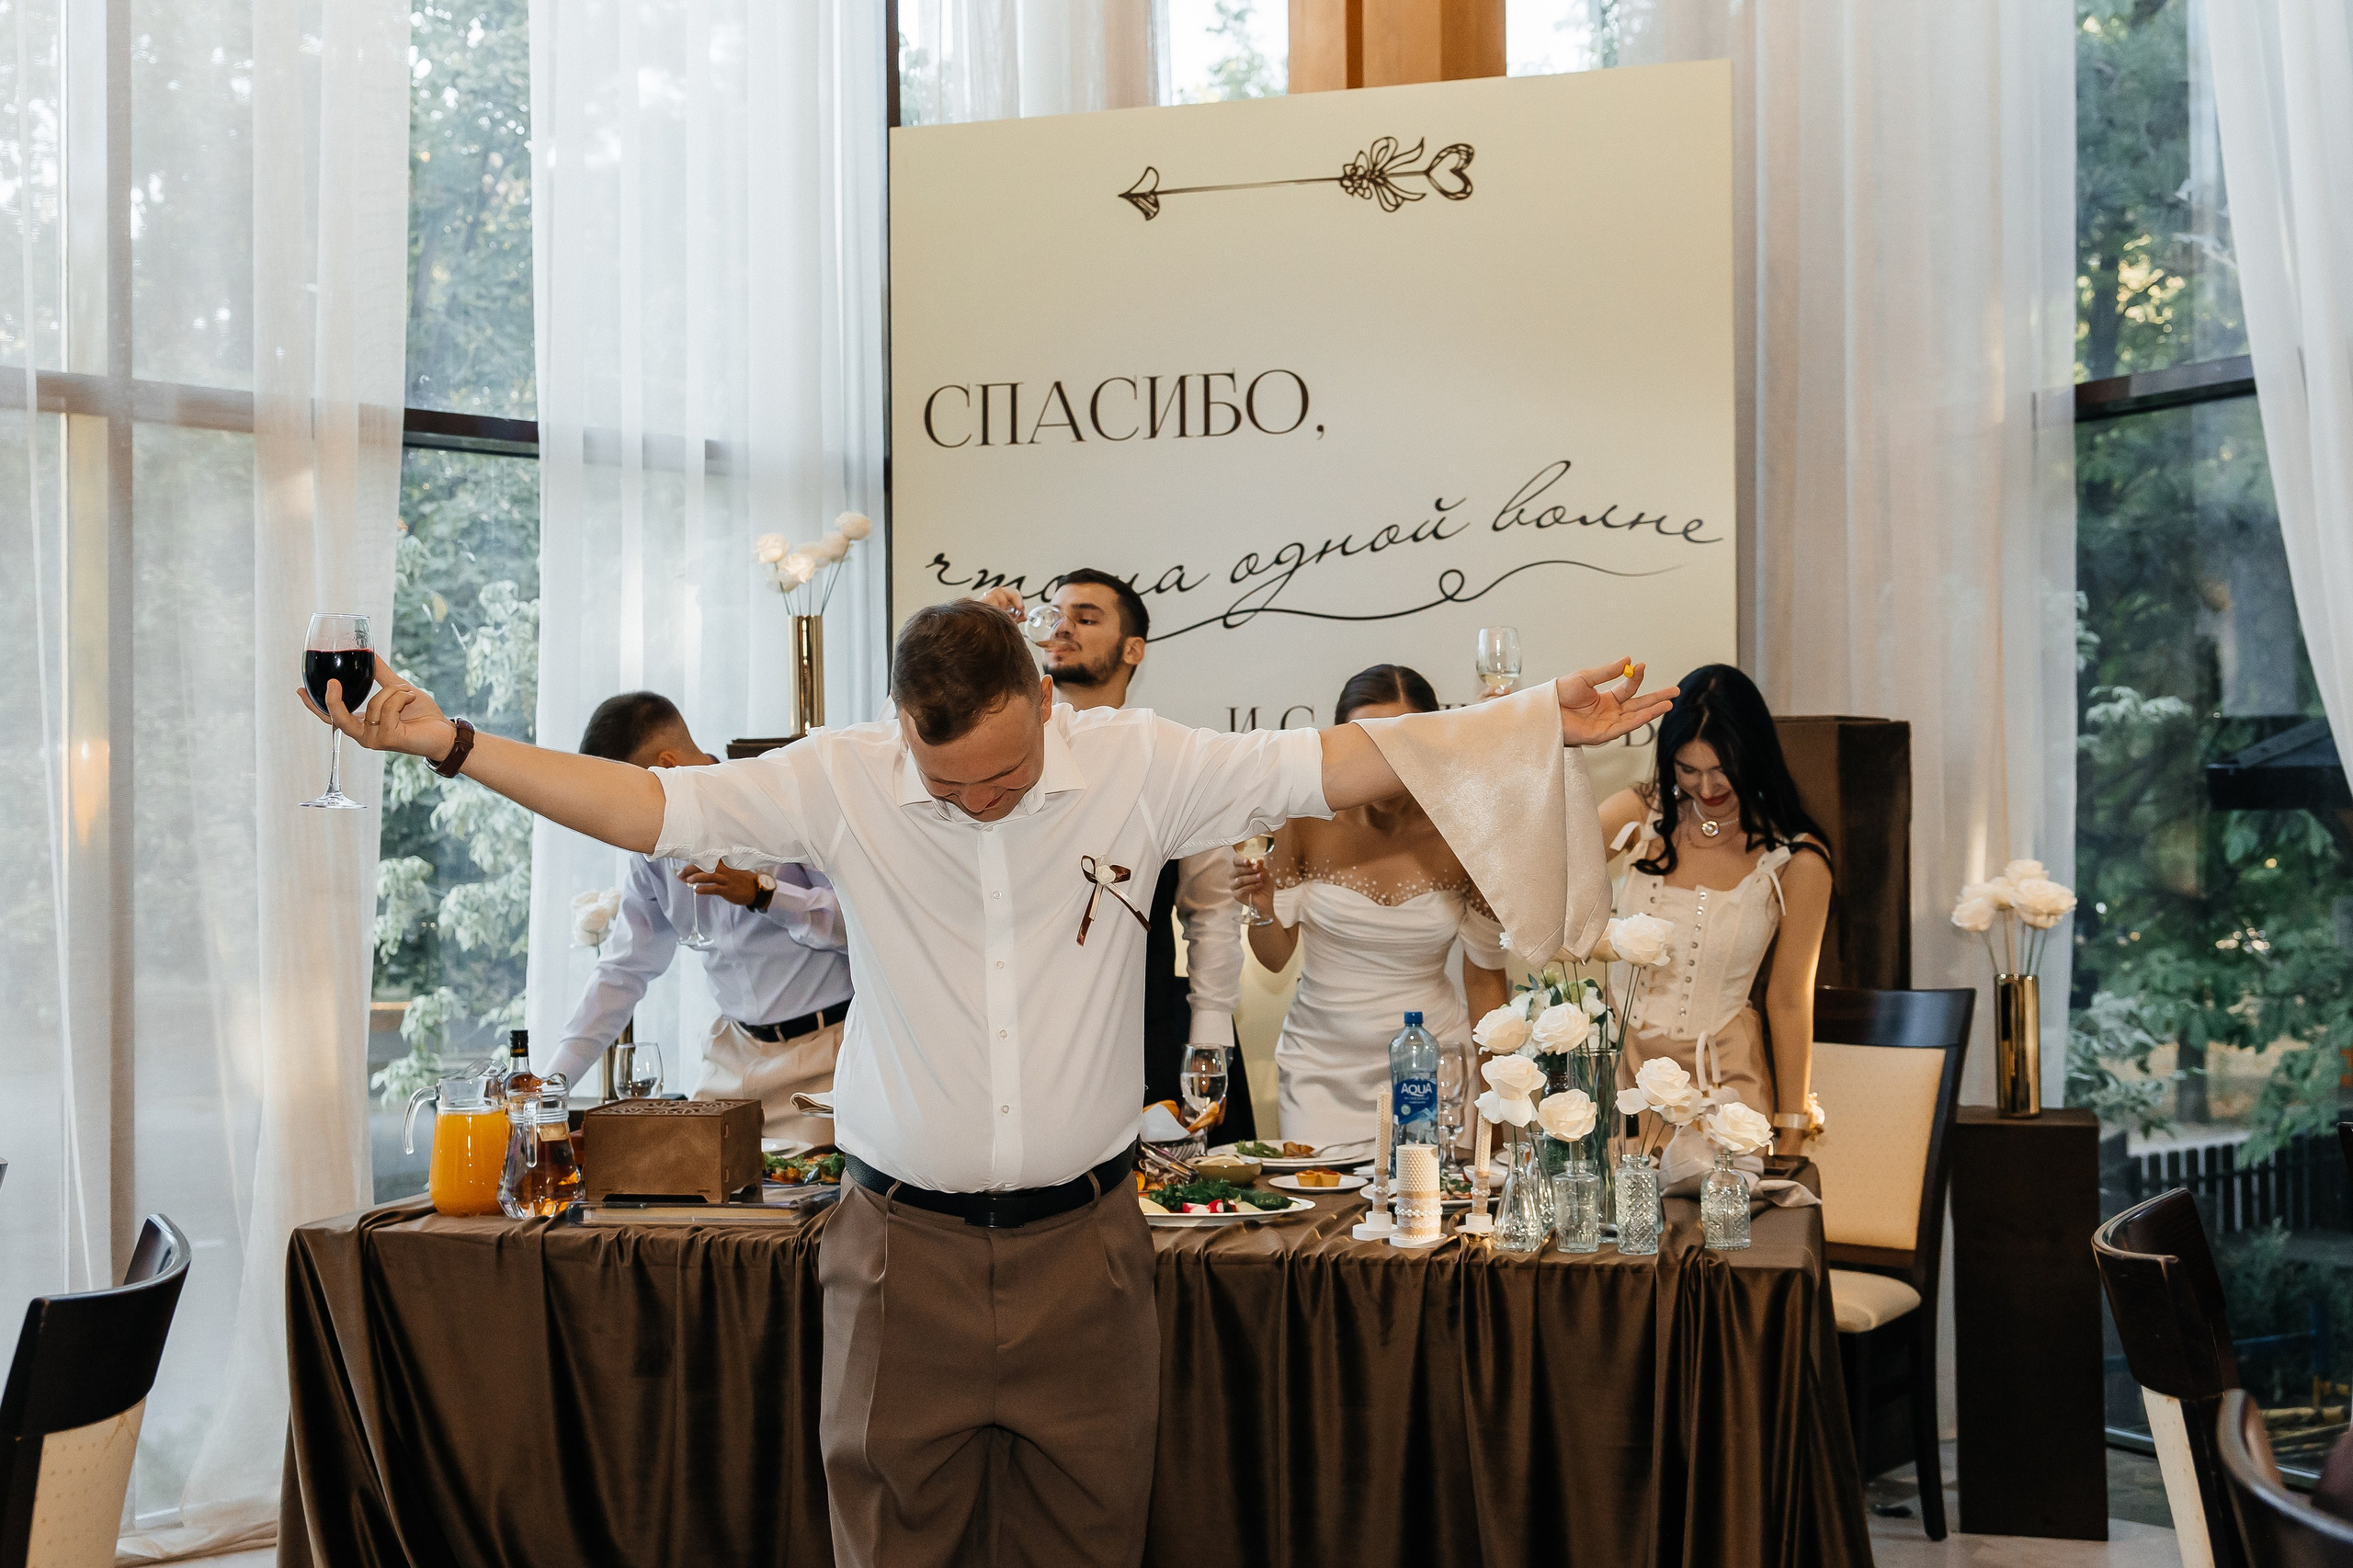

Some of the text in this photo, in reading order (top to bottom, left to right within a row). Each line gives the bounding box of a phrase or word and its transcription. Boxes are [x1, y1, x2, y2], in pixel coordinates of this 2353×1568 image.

[924, 368, 1325, 449] СПАСИБО,
[1222, 497, 1470, 629] одной
[1491, 460, 1724, 543] волне
[1401, 1083, 1433, 1096] AQUA
